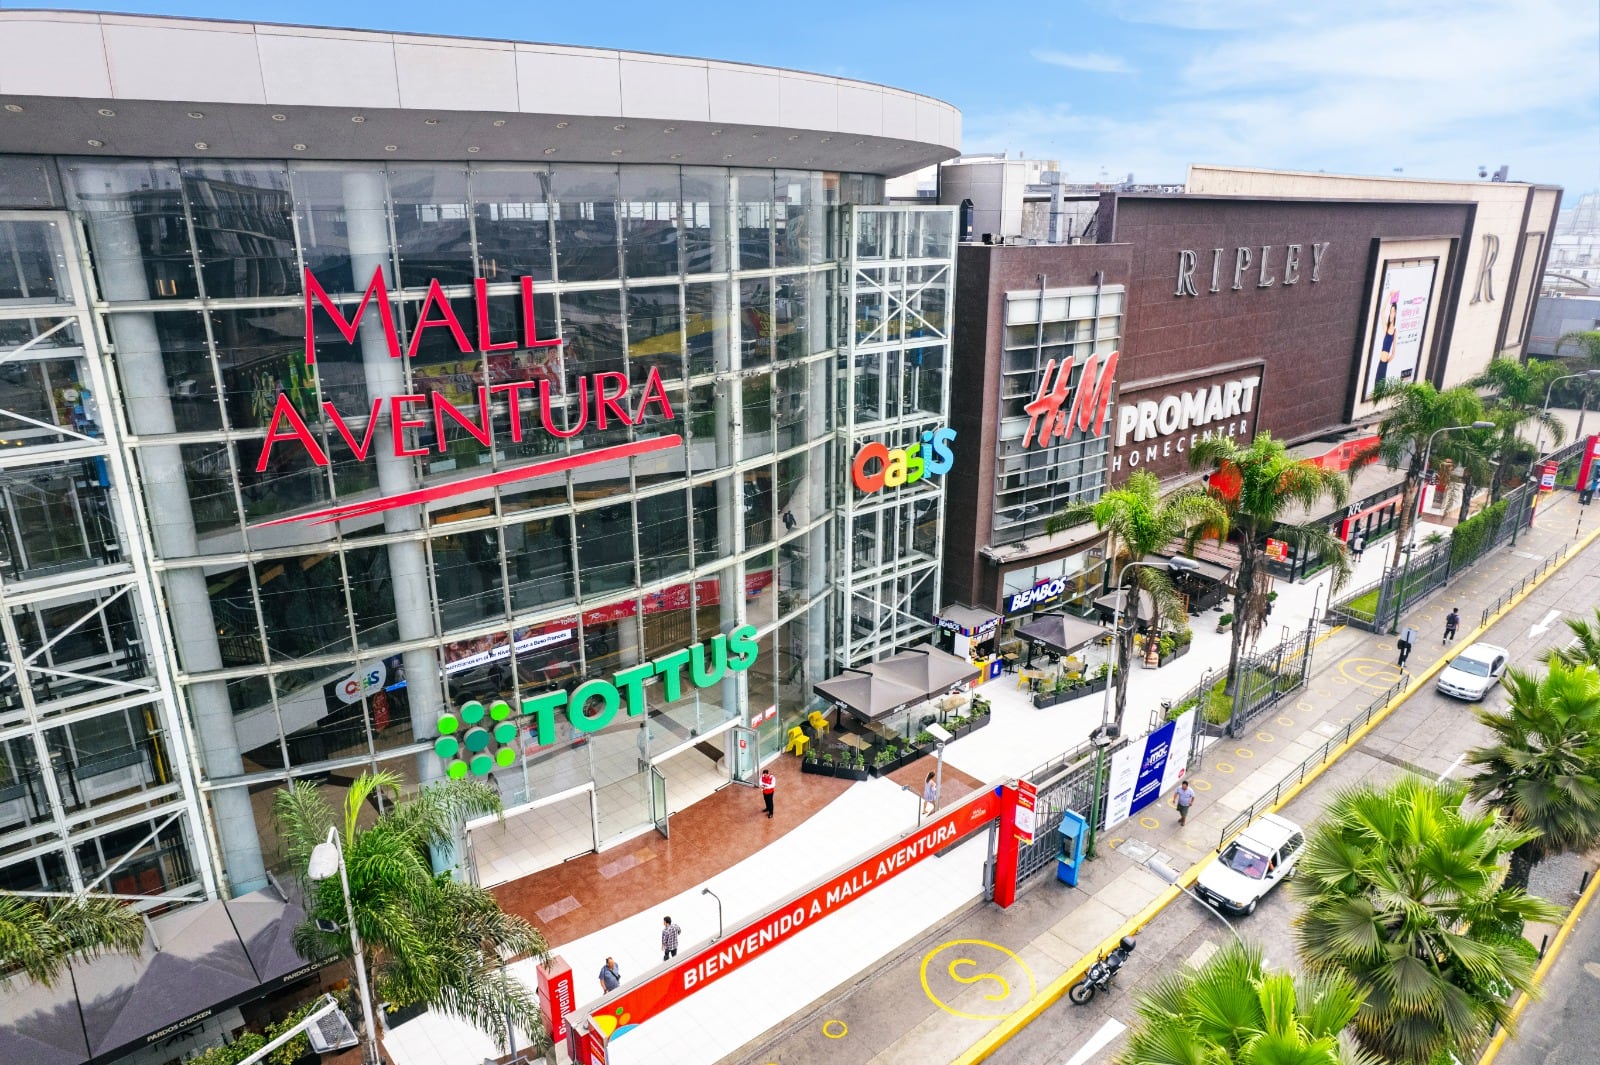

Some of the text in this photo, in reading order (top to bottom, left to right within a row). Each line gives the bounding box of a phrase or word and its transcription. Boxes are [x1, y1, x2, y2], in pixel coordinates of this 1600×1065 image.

[1174, 241, 1331, 297] RIPLEY
[1469, 232, 1501, 306] R
[303, 263, 562, 366] MALL
[256, 365, 676, 473] AVENTURA
[1021, 350, 1120, 449] H&M
[1114, 375, 1261, 448] PROMART
[1112, 418, 1248, 473] HOMECENTER
[937, 618, 960, 632] BEMBOS
[1010, 576, 1068, 612] BEMBOS
[520, 623, 760, 747] TOTTUS
[683, 820, 957, 991] BIENVENIDO A MALL AVENTURA
[283, 965, 310, 982] PARDOS
[146, 1009, 212, 1042] PARDOS CHICKEN
